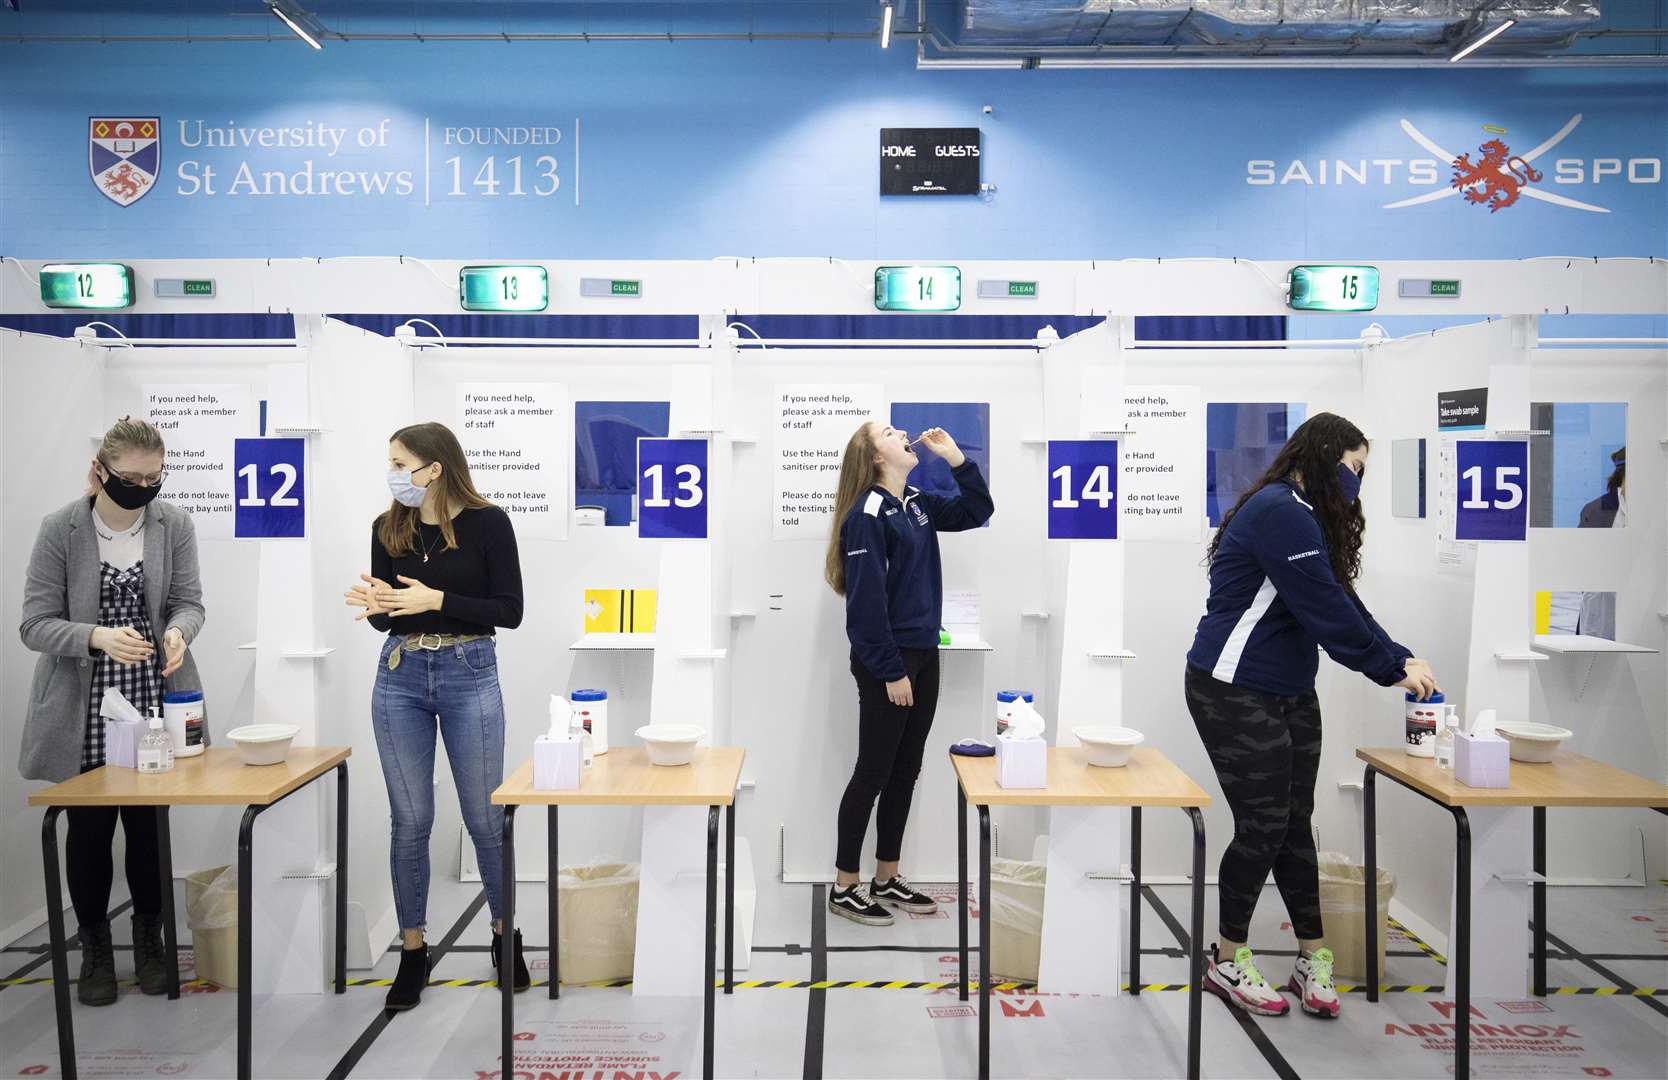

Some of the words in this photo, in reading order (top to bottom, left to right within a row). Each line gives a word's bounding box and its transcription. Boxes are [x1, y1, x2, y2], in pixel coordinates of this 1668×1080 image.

[177, 119, 347, 157] University
[357, 118, 391, 147] of
[444, 126, 561, 145] FOUNDED
[881, 145, 917, 157] HOME
[935, 145, 981, 157] GUESTS
[444, 154, 560, 196] 1413
[1246, 159, 1439, 185] SAINTS
[1554, 158, 1661, 184] SPO
[177, 160, 217, 195] St
[227, 159, 414, 196] Andrews
[77, 272, 95, 298] 12
[186, 283, 210, 292] CLEAN
[502, 275, 518, 300] 13
[612, 284, 638, 292] CLEAN
[918, 276, 933, 300] 14
[1009, 285, 1034, 293] CLEAN
[1342, 274, 1358, 300] 15
[1431, 284, 1456, 292] CLEAN
[150, 392, 156, 402] If
[157, 396, 174, 405] you
[174, 393, 196, 403] need
[197, 393, 219, 405] help,
[464, 394, 472, 402] If
[472, 395, 489, 405] you
[490, 393, 513, 403] need
[513, 393, 536, 405] help,
[782, 394, 788, 402] If
[790, 395, 807, 405] you
[808, 393, 830, 403] need
[831, 393, 853, 405] help,
[1124, 395, 1146, 405] need
[1147, 395, 1169, 407] help,
[149, 406, 177, 418] please
[177, 406, 193, 416] ask
[200, 406, 237, 416] member
[464, 406, 492, 417] please
[493, 406, 509, 416] ask
[517, 406, 554, 416] member
[782, 406, 810, 417] please
[810, 406, 827, 416] ask
[834, 406, 872, 416] member
[1127, 409, 1143, 418] ask
[1150, 409, 1187, 418] member
[1462, 404, 1479, 416] sample
[160, 420, 180, 430] staff
[464, 419, 475, 429] of
[475, 419, 495, 429] staff
[782, 420, 792, 429] of
[792, 420, 813, 429] staff
[166, 449, 182, 458] the
[182, 449, 205, 458] Hand
[464, 448, 481, 458] Use
[482, 448, 497, 458] the
[498, 448, 522, 458] Hand
[782, 449, 799, 458] Use
[799, 448, 815, 458] the
[816, 449, 839, 458] Hand
[1132, 450, 1155, 460] Hand
[186, 462, 224, 473] provided
[467, 462, 501, 471] anitiser
[502, 462, 541, 473] provided
[781, 462, 819, 472] sanitiser
[1135, 464, 1174, 475] provided
[238, 462, 299, 507] 12
[643, 463, 704, 508] 13
[1052, 465, 1114, 509] 14
[1462, 465, 1523, 510] 15
[156, 492, 177, 500] ease
[177, 490, 190, 500] do
[191, 491, 206, 500] not
[207, 490, 230, 500] leave
[493, 490, 505, 500] do
[506, 491, 522, 500] not
[523, 490, 547, 500] leave
[782, 490, 810, 500] Please
[810, 490, 823, 500] do
[1127, 492, 1139, 502] do
[1140, 493, 1156, 502] not
[1156, 492, 1180, 502] leave
[195, 503, 212, 515] bay
[213, 503, 233, 513] until
[511, 504, 528, 515] bay
[528, 503, 549, 513] until
[782, 503, 797, 513] the
[798, 504, 828, 515] testing
[1145, 506, 1162, 517] bay
[1162, 506, 1183, 515] until
[781, 517, 800, 526] told
